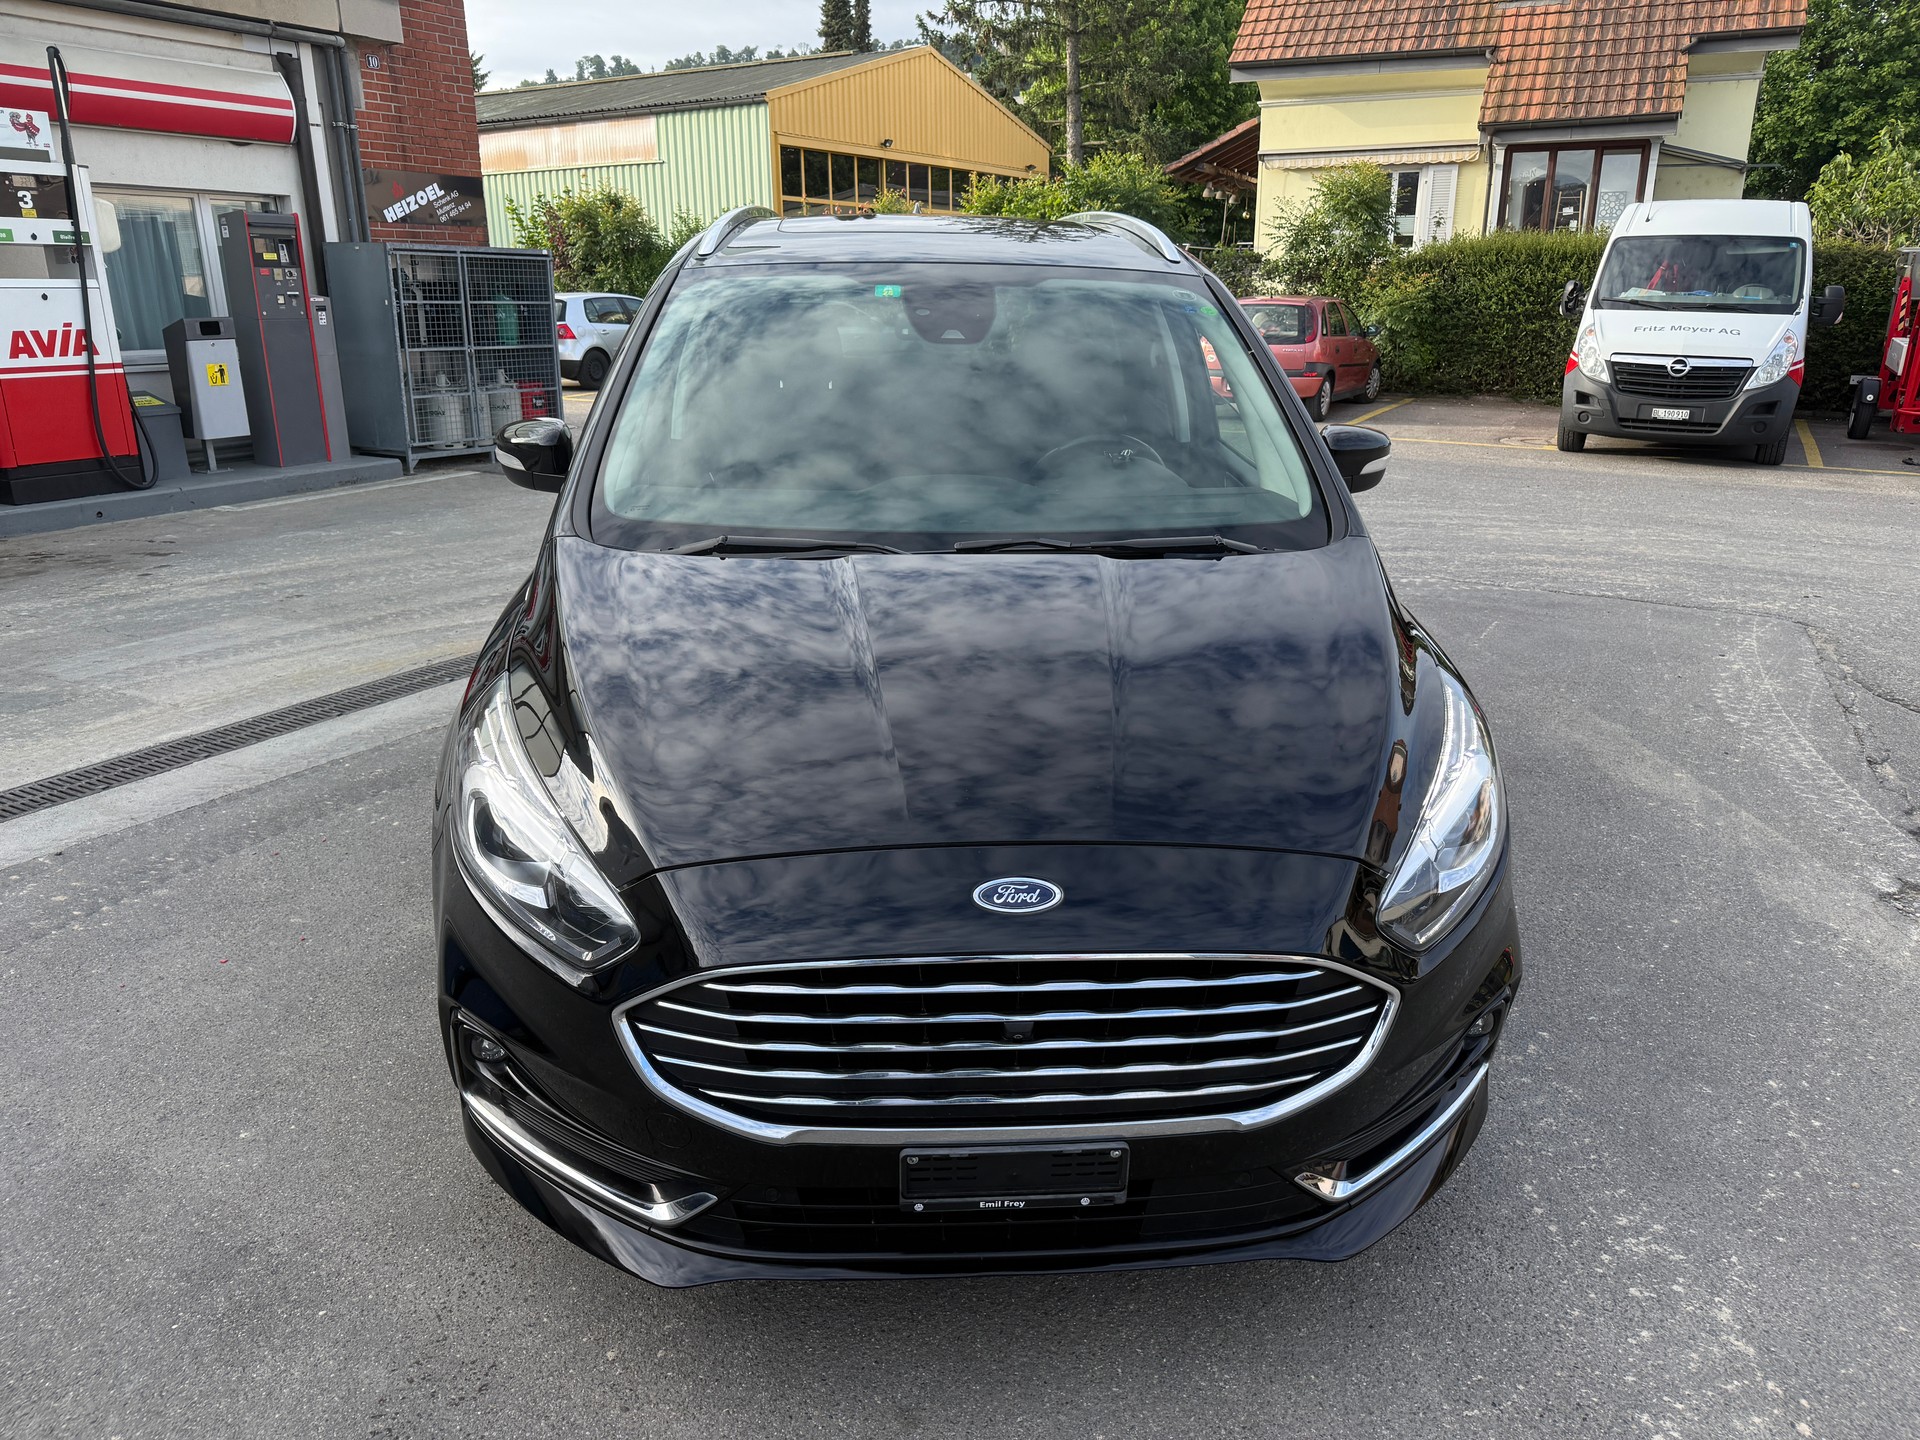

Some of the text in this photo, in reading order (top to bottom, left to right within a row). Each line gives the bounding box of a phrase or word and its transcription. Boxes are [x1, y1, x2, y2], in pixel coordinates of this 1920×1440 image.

[368, 56, 378, 67] 10
[17, 190, 34, 209] 3
[383, 182, 445, 223] HEIZOEL
[433, 190, 459, 209] Schenk AG
[436, 202, 456, 216] Muttenz
[439, 213, 450, 223] 061
[1633, 325, 1741, 336] Fritz Meyer AG
[993, 884, 1041, 904] Ford
[979, 1200, 1026, 1209] Emil Frey
